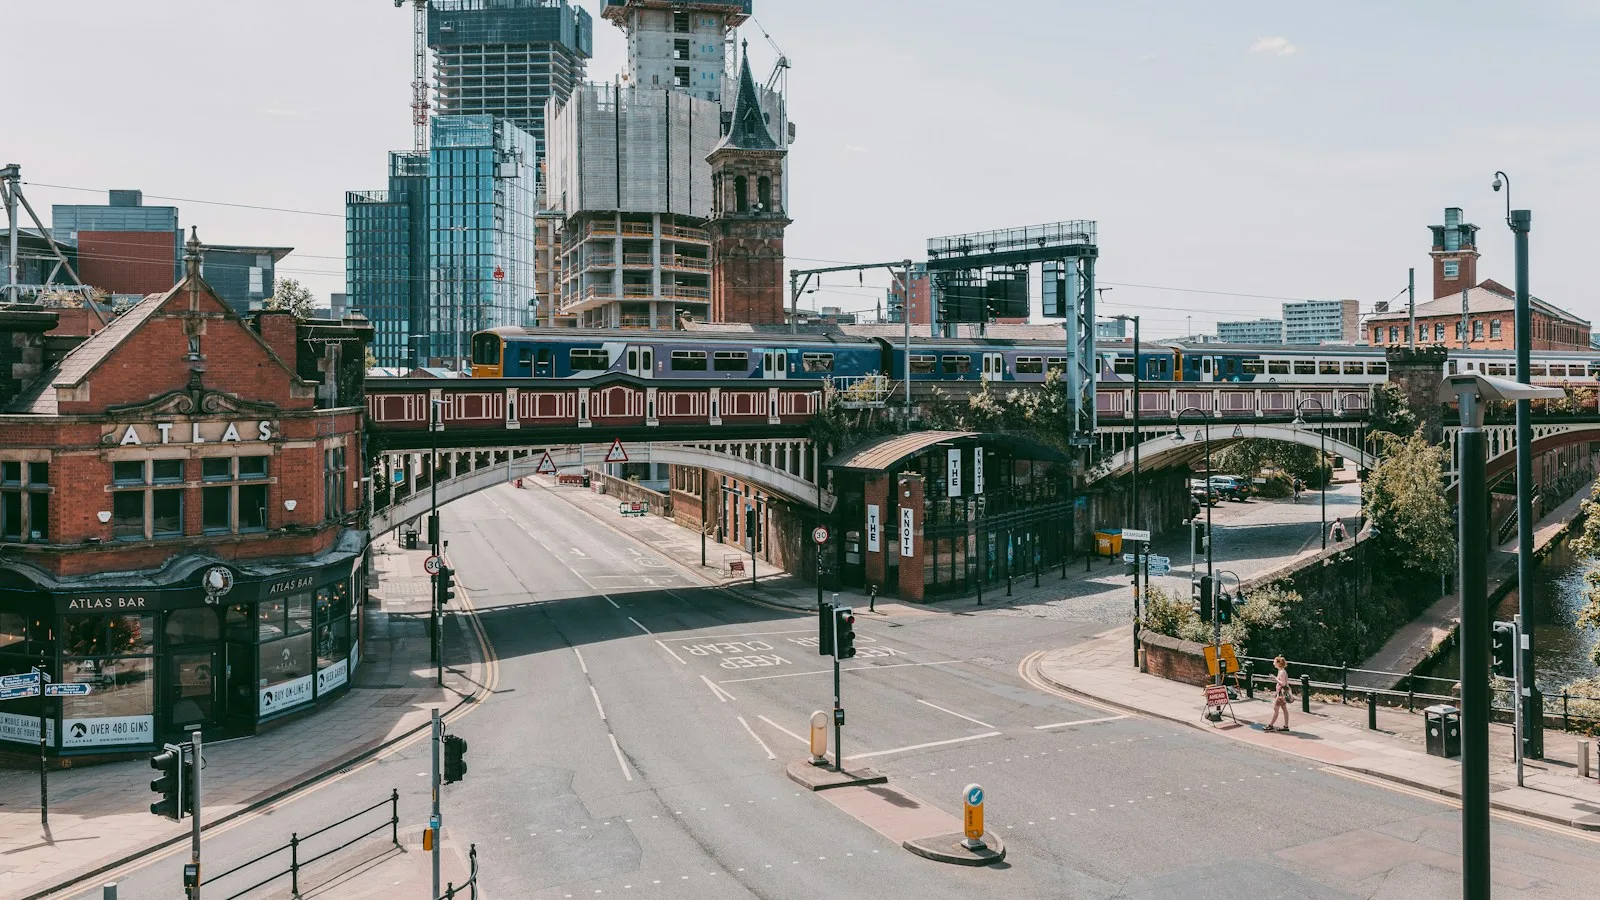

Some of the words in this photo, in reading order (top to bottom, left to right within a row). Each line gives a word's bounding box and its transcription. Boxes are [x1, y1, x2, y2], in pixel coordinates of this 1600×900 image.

[702, 45, 714, 53] 15
[120, 420, 271, 446] ATLAS
[816, 531, 827, 539] 30
[269, 580, 296, 594] ATLAS
[297, 576, 313, 588] BAR
[69, 598, 112, 609] ATLAS
[118, 597, 146, 608] BAR
[682, 641, 774, 656] CLEAR
[720, 654, 792, 669] KEEP
[274, 689, 284, 701] BUY
[285, 683, 304, 698] ON-LINE
[90, 723, 110, 735] OVER
[112, 722, 127, 734] 480
[130, 721, 149, 733] GINS
